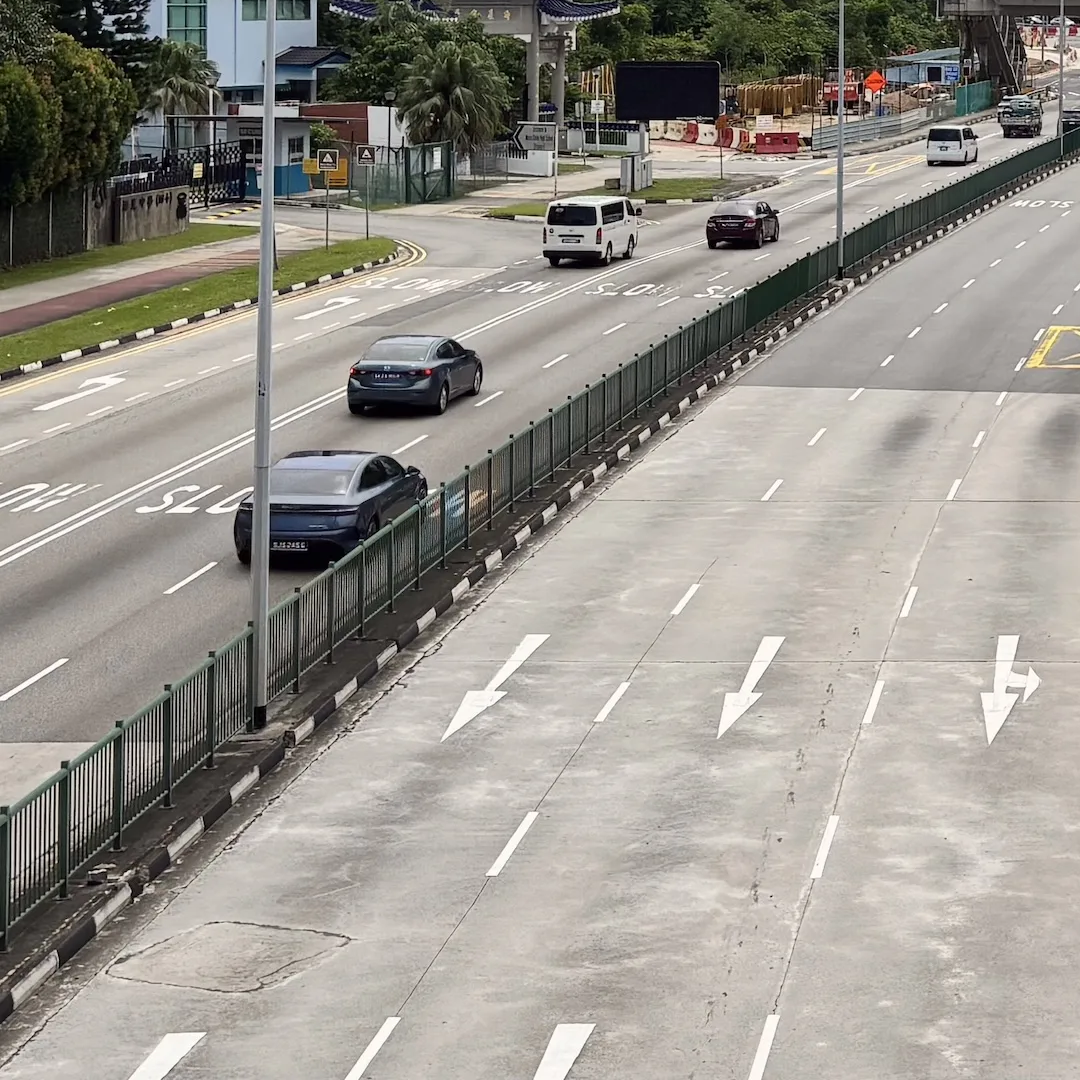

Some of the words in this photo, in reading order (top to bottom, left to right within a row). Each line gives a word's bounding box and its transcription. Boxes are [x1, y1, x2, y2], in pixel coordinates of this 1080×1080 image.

[1009, 199, 1074, 209] SLOW
[350, 277, 468, 294] SLOW
[135, 485, 254, 514] SLO
